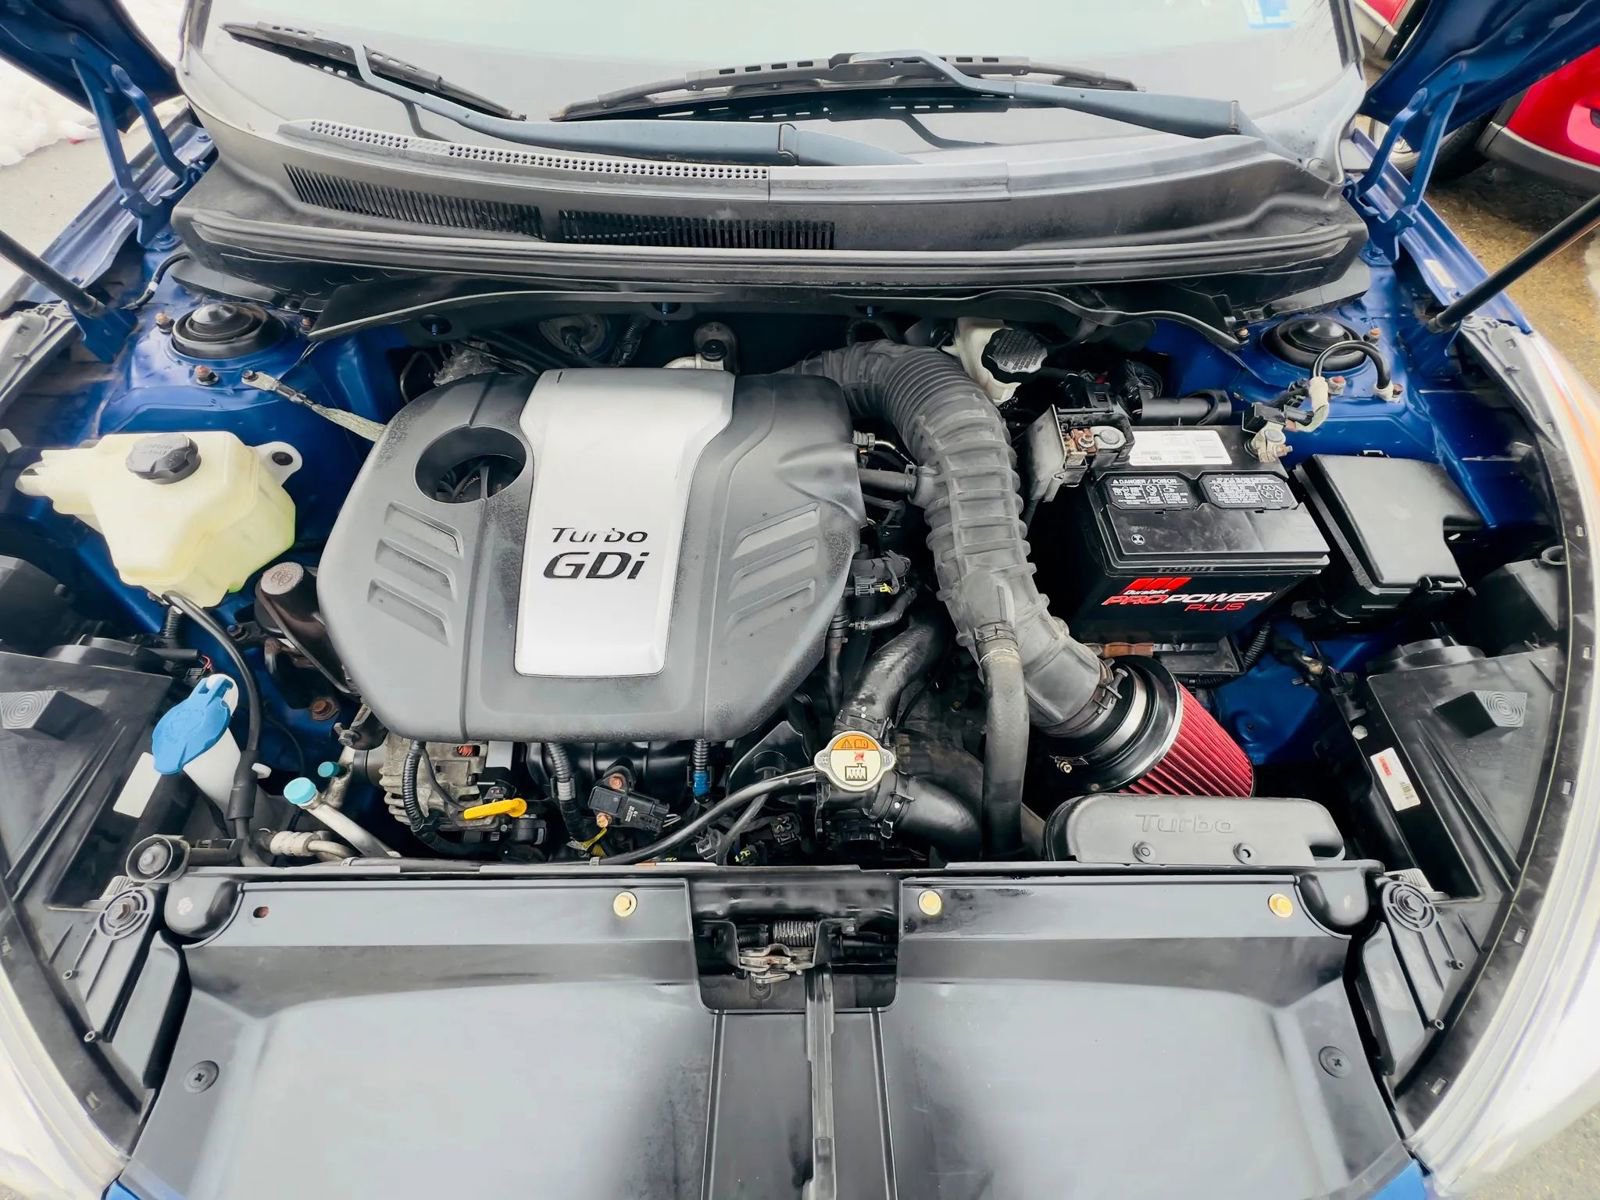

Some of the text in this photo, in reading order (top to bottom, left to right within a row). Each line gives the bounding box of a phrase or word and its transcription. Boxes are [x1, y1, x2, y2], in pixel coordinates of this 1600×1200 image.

[543, 552, 650, 580] GDi
[1184, 603, 1245, 612] PLUS
[1135, 813, 1234, 834] Turbo
